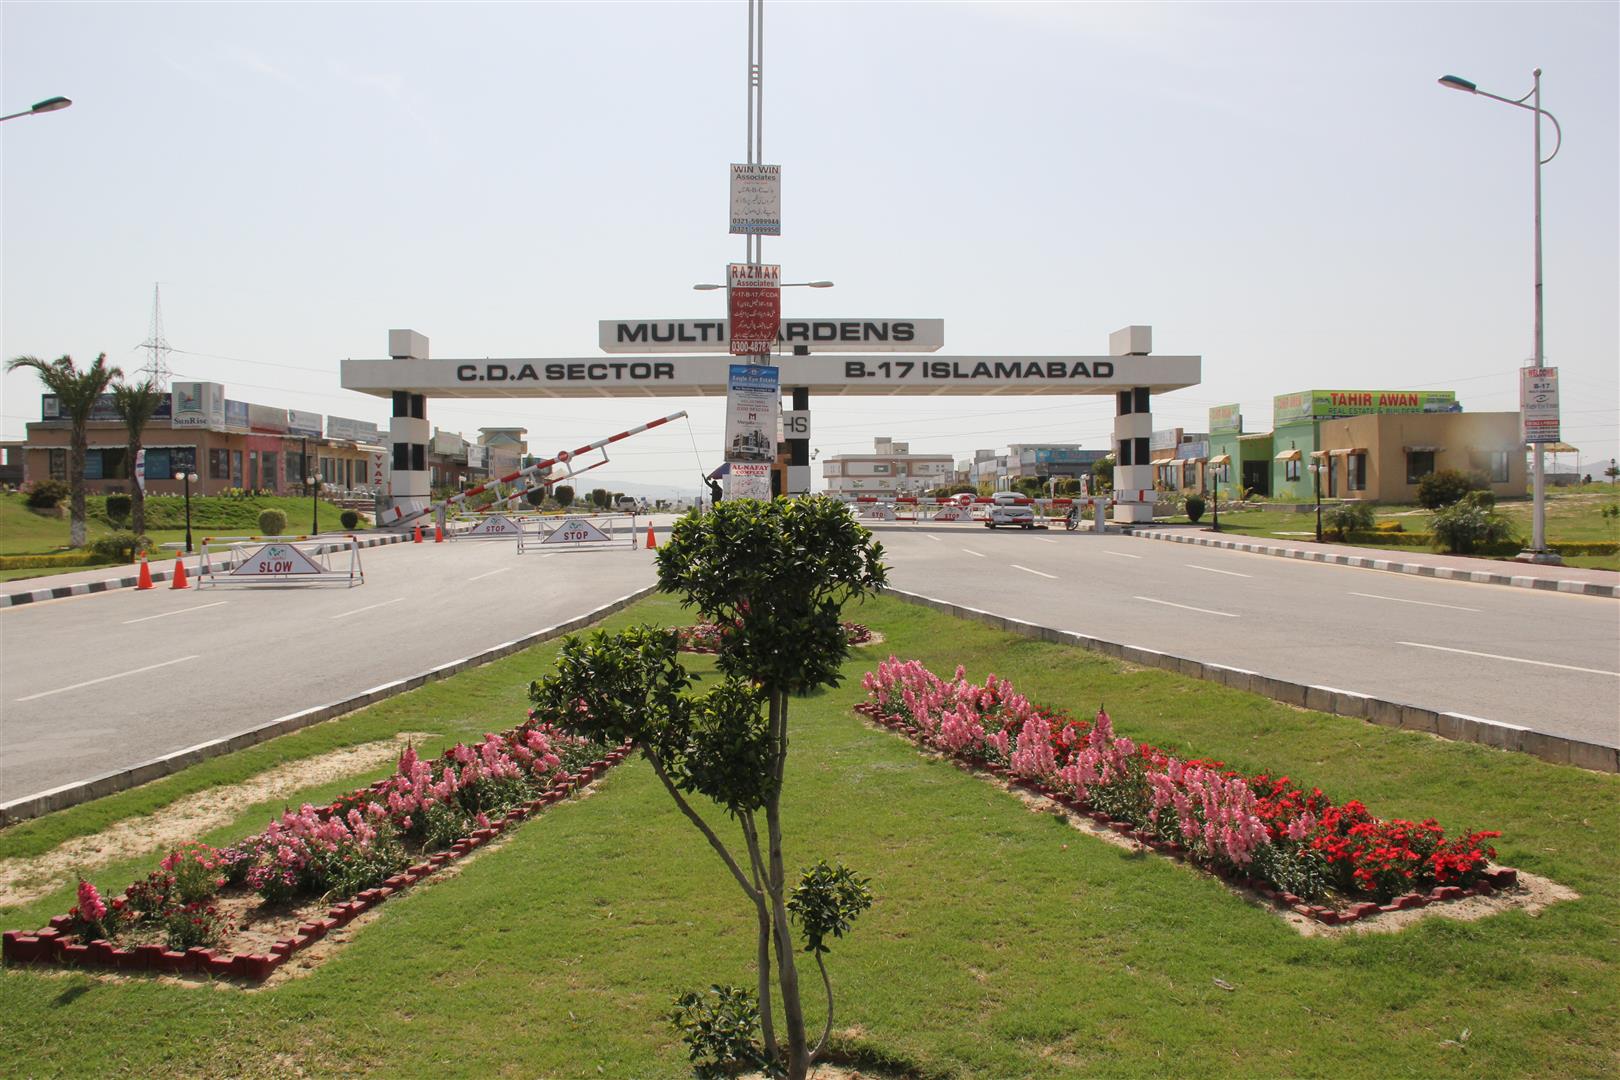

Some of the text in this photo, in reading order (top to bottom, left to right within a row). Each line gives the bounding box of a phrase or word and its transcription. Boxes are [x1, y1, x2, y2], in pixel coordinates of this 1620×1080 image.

[758, 166, 779, 174] WIN
[732, 266, 778, 279] RAZMAK
[779, 322, 914, 341] RDENS
[545, 362, 674, 381] SECTOR
[846, 361, 1114, 379] B-17 ISLAMABAD
[1330, 392, 1373, 406] TAHIR
[1379, 393, 1418, 407] AWAN
[174, 417, 207, 425] SunRise
[784, 417, 807, 432] HS
[375, 455, 383, 485] YYAZ
[486, 525, 505, 533] STOP
[564, 531, 589, 540] STOP
[259, 560, 293, 573] SLOW
